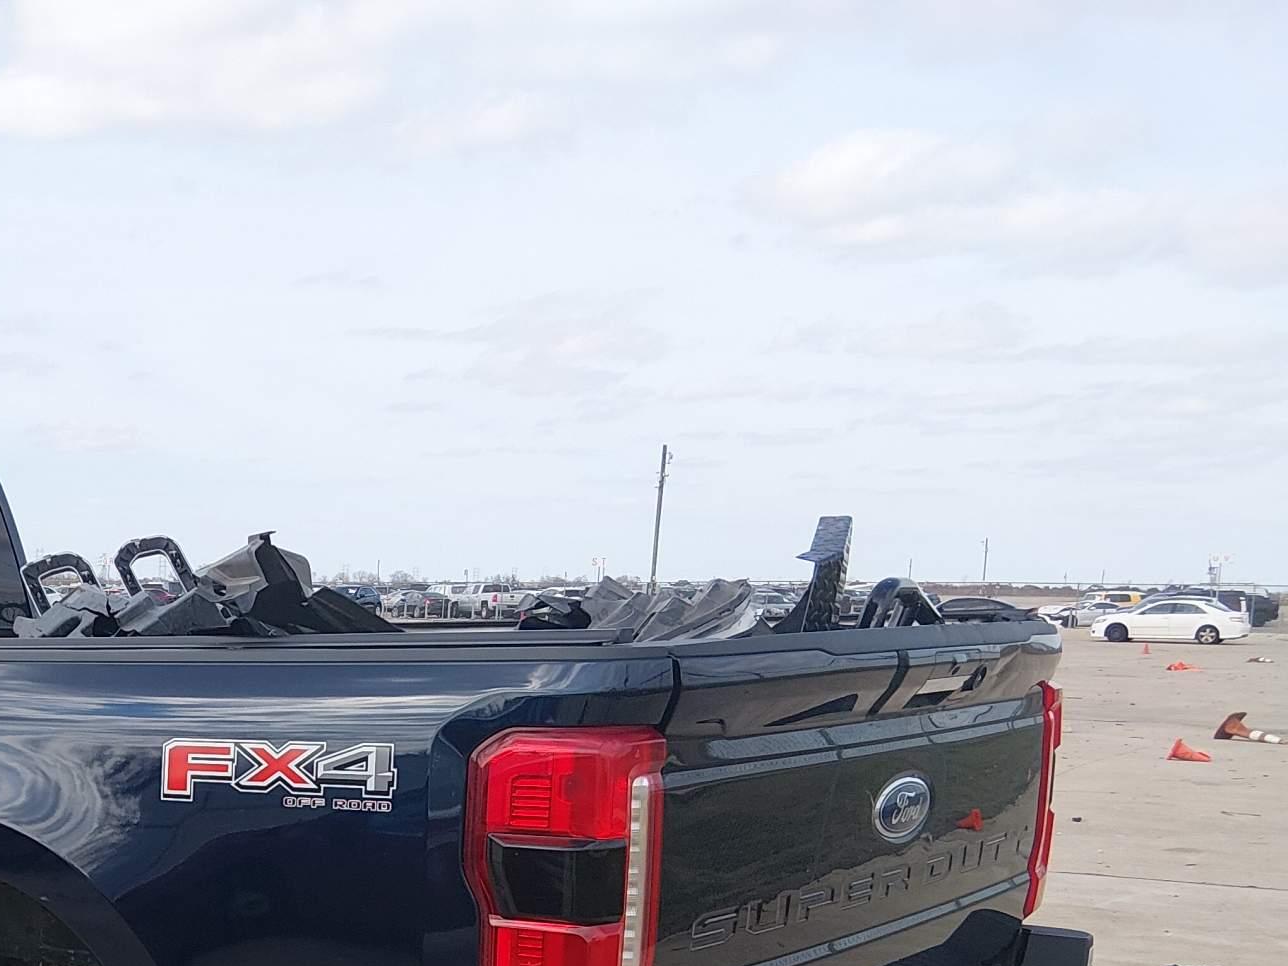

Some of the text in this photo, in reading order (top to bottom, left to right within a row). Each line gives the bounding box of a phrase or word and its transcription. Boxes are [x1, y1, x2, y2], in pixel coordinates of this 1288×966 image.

[161, 737, 398, 802] FX4
[282, 796, 393, 812] OFF ROAD
[891, 790, 924, 825] Ford
[690, 863, 911, 951] SUPER
